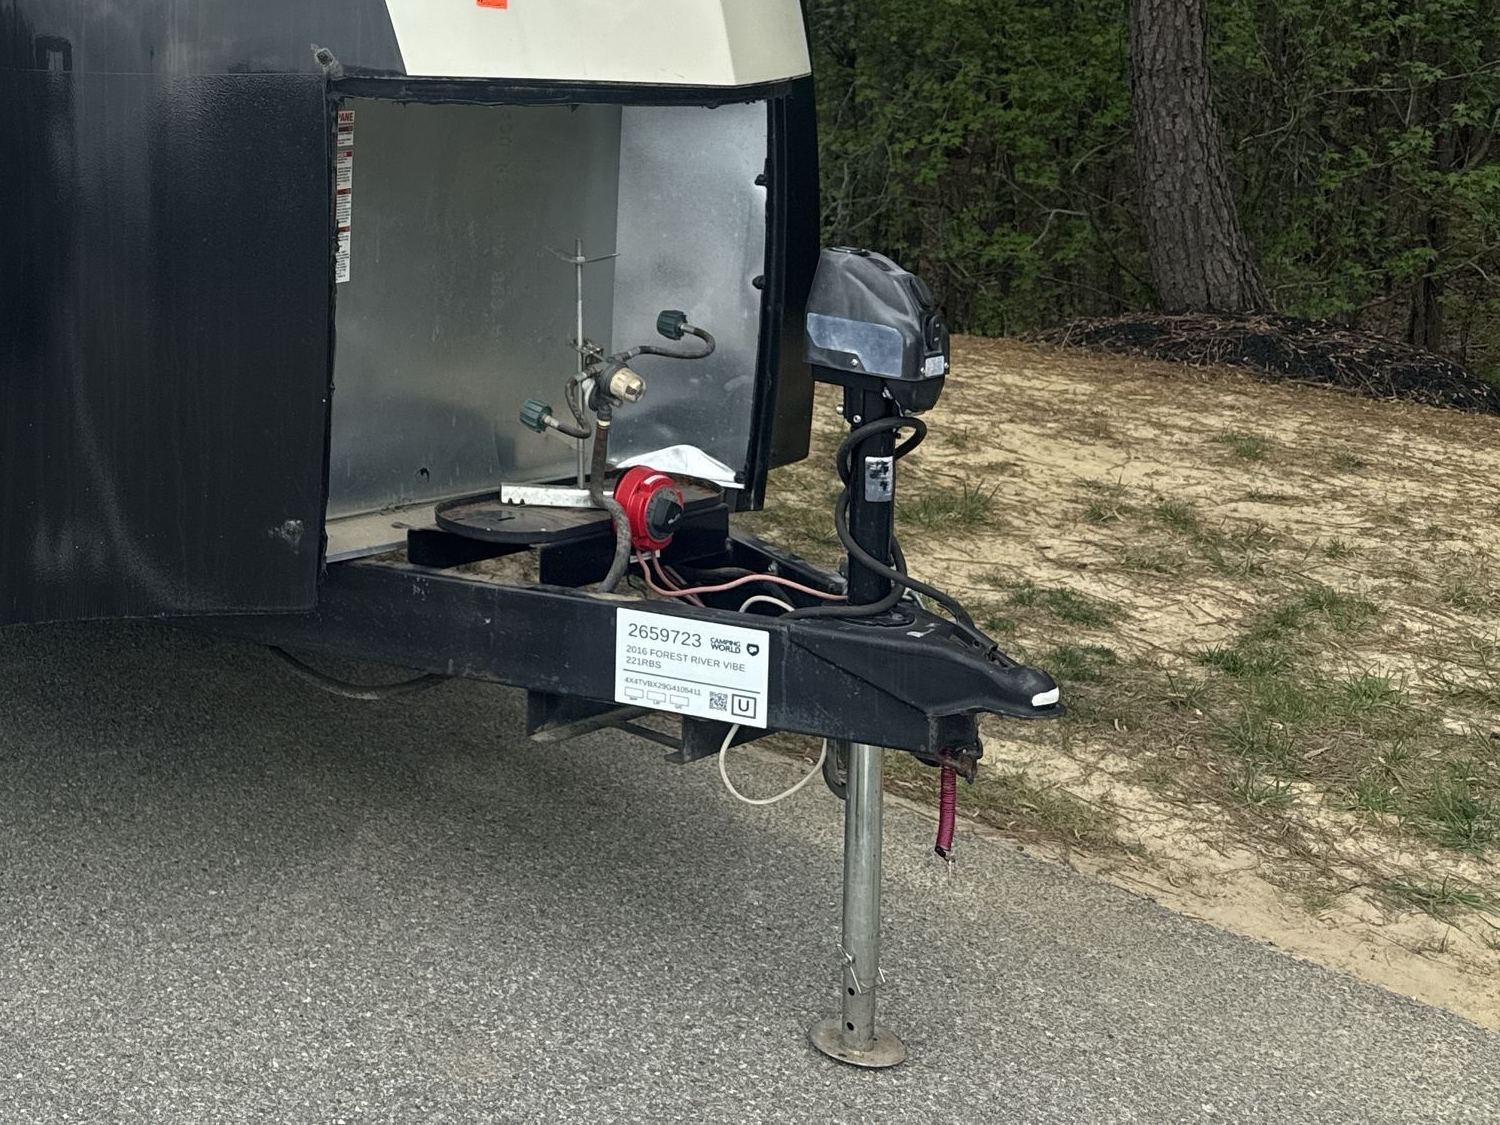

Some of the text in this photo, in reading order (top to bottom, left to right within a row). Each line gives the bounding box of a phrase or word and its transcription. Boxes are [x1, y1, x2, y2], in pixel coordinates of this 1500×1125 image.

[628, 623, 702, 648] 2659723
[710, 637, 741, 648] CAMPING
[711, 643, 741, 654] WORLD
[626, 644, 746, 673] 2016 FOREST RIVER VIBE
[626, 656, 662, 669] 221RBS
[738, 698, 750, 712] U
